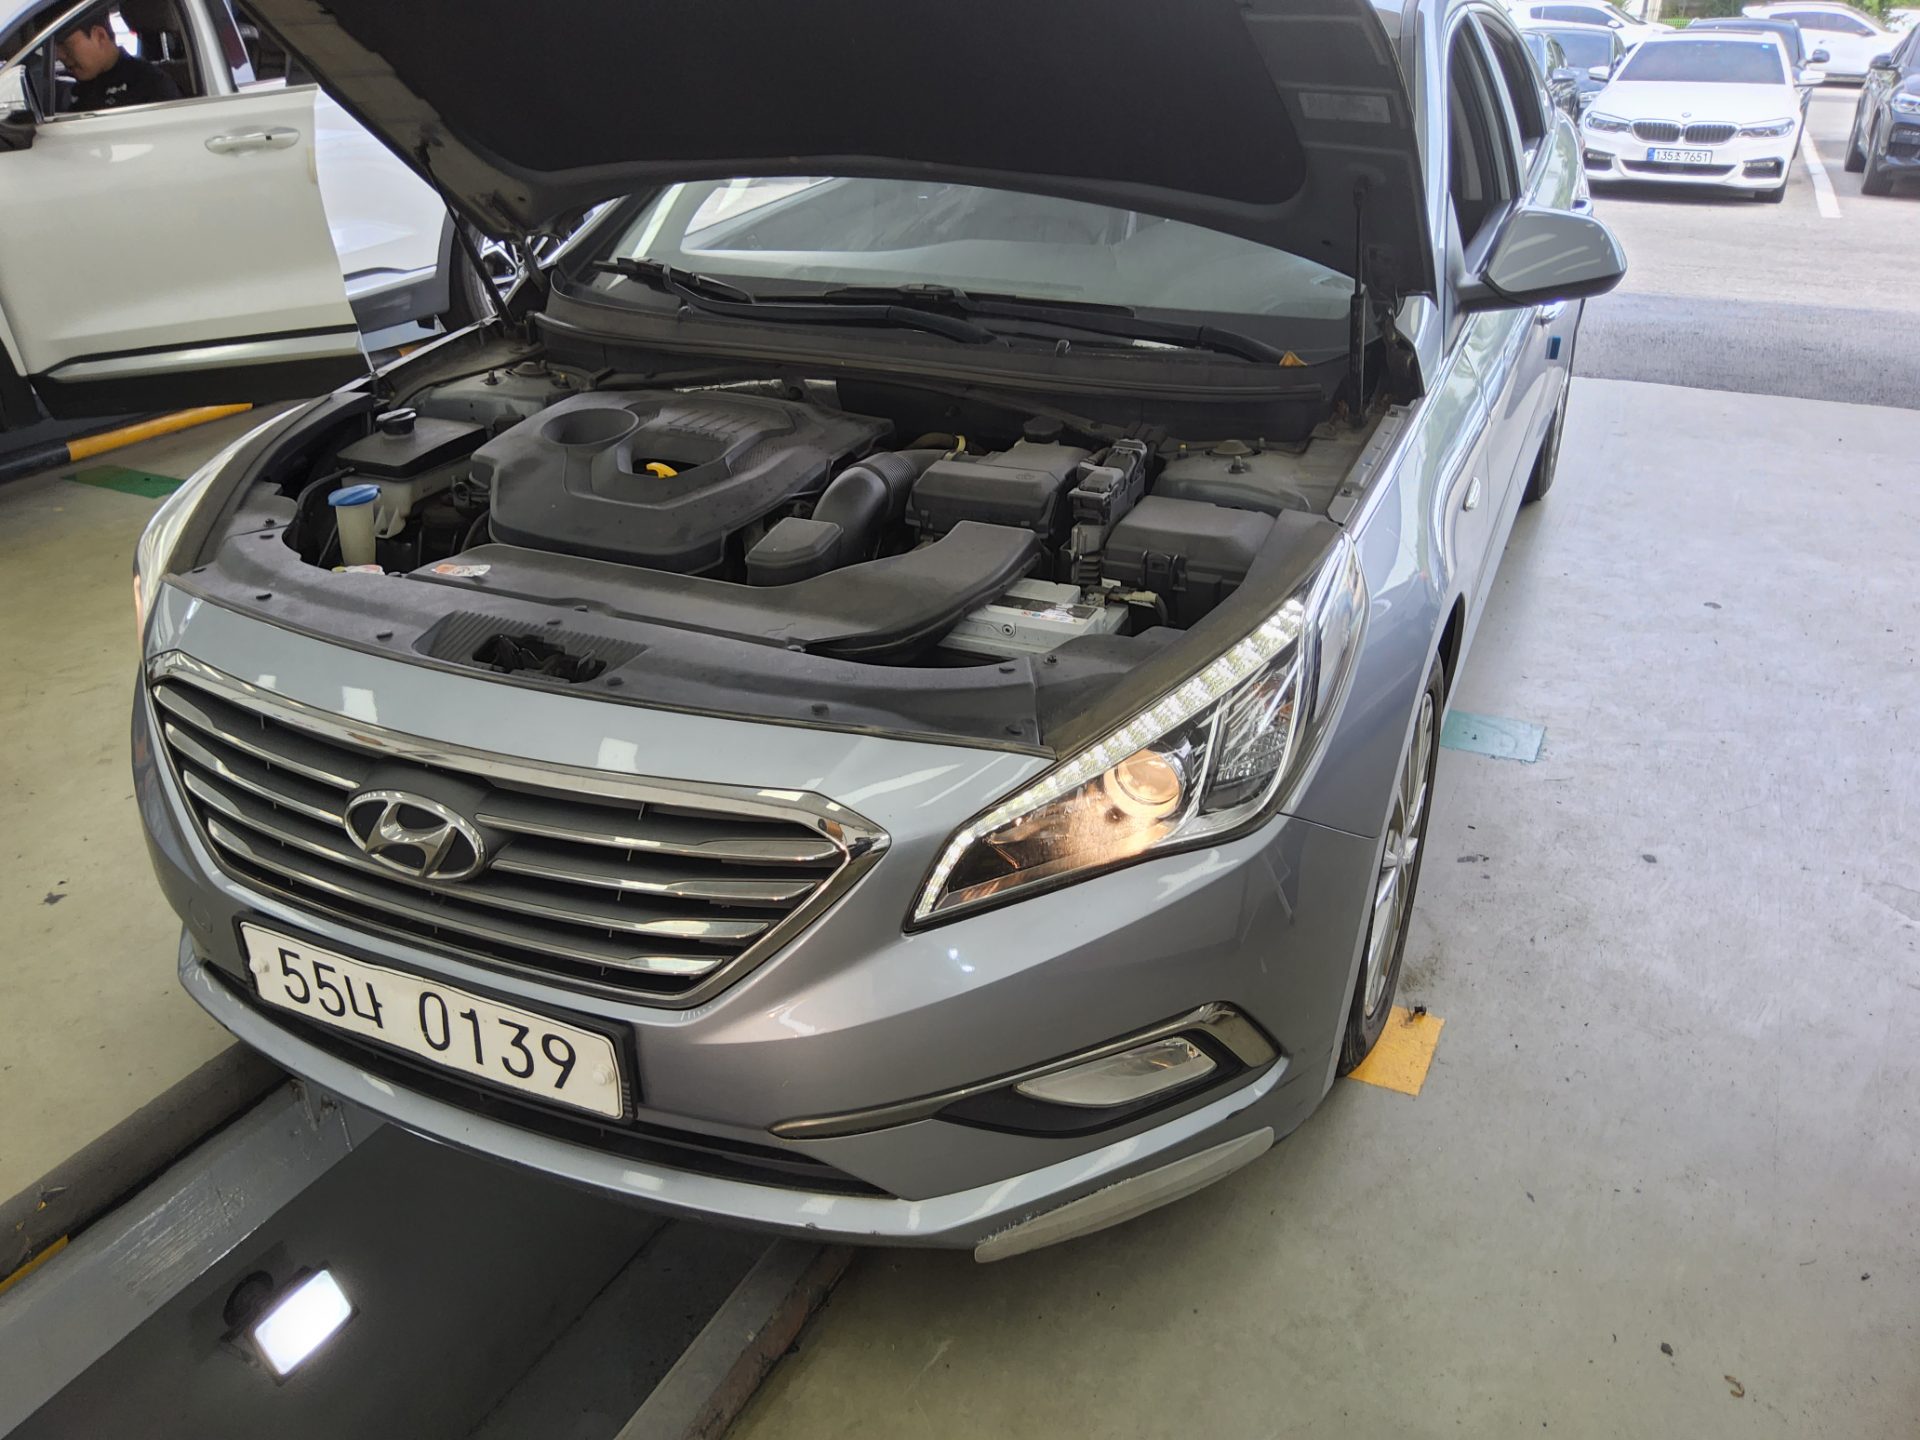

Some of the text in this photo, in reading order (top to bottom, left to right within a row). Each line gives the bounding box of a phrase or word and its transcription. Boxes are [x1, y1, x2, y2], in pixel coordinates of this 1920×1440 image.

[1684, 151, 1708, 162] 7651
[278, 947, 576, 1089] 55나 0139
